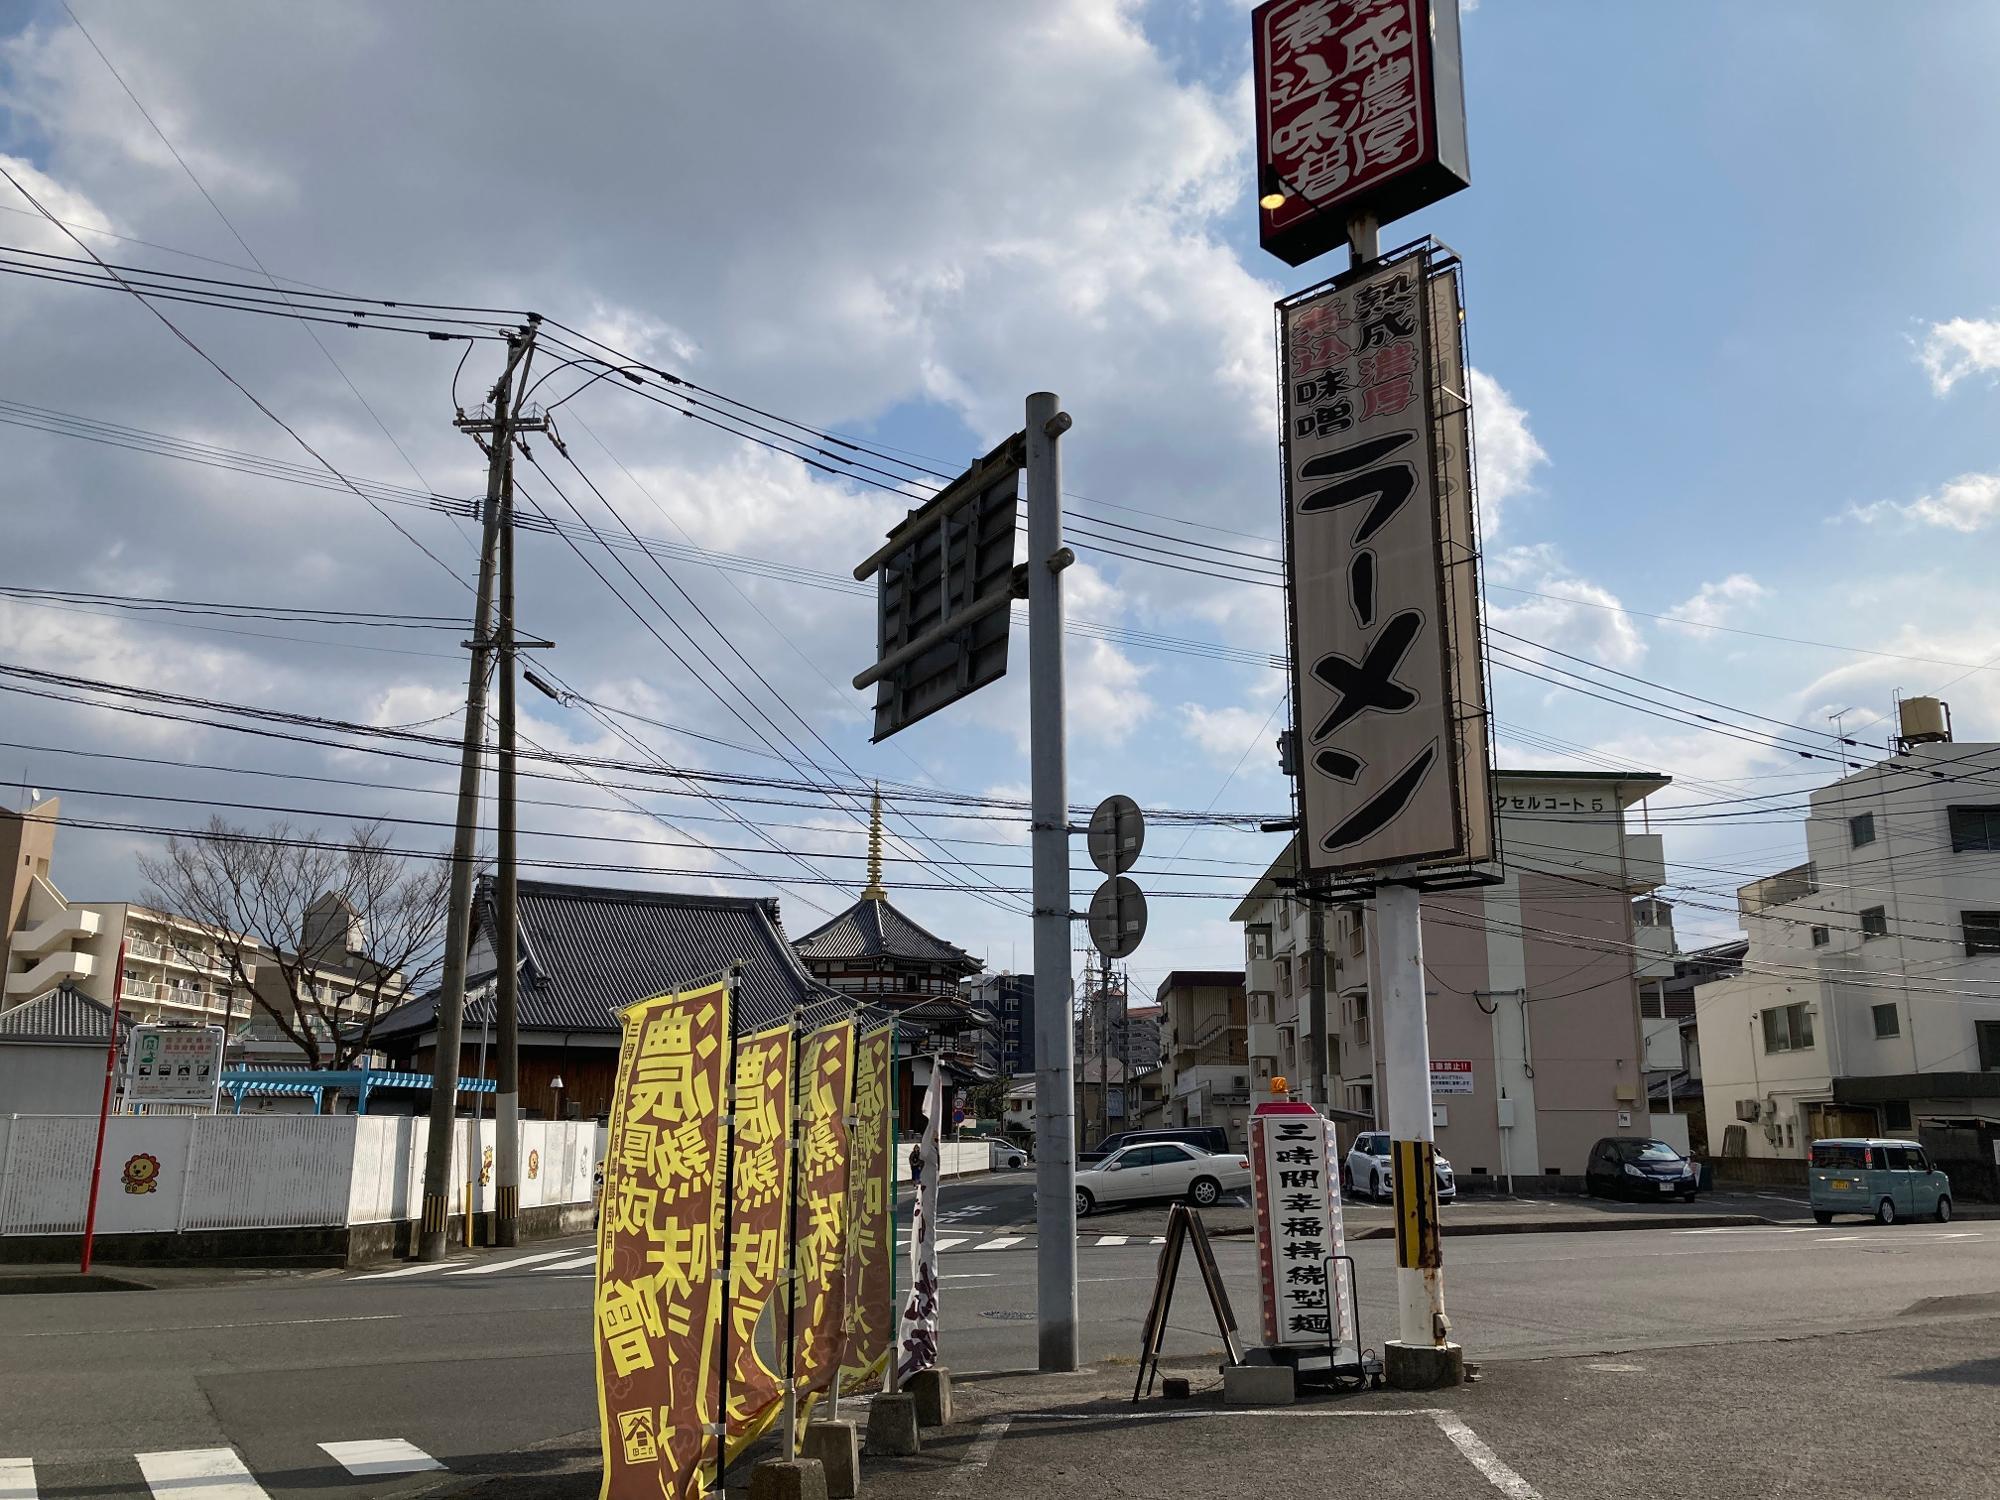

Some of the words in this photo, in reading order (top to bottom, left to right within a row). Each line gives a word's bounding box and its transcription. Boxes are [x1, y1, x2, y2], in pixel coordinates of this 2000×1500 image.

[1298, 429, 1438, 853] ラーメン
[1274, 1123, 1330, 1334] 三時間幸福持続型麺
